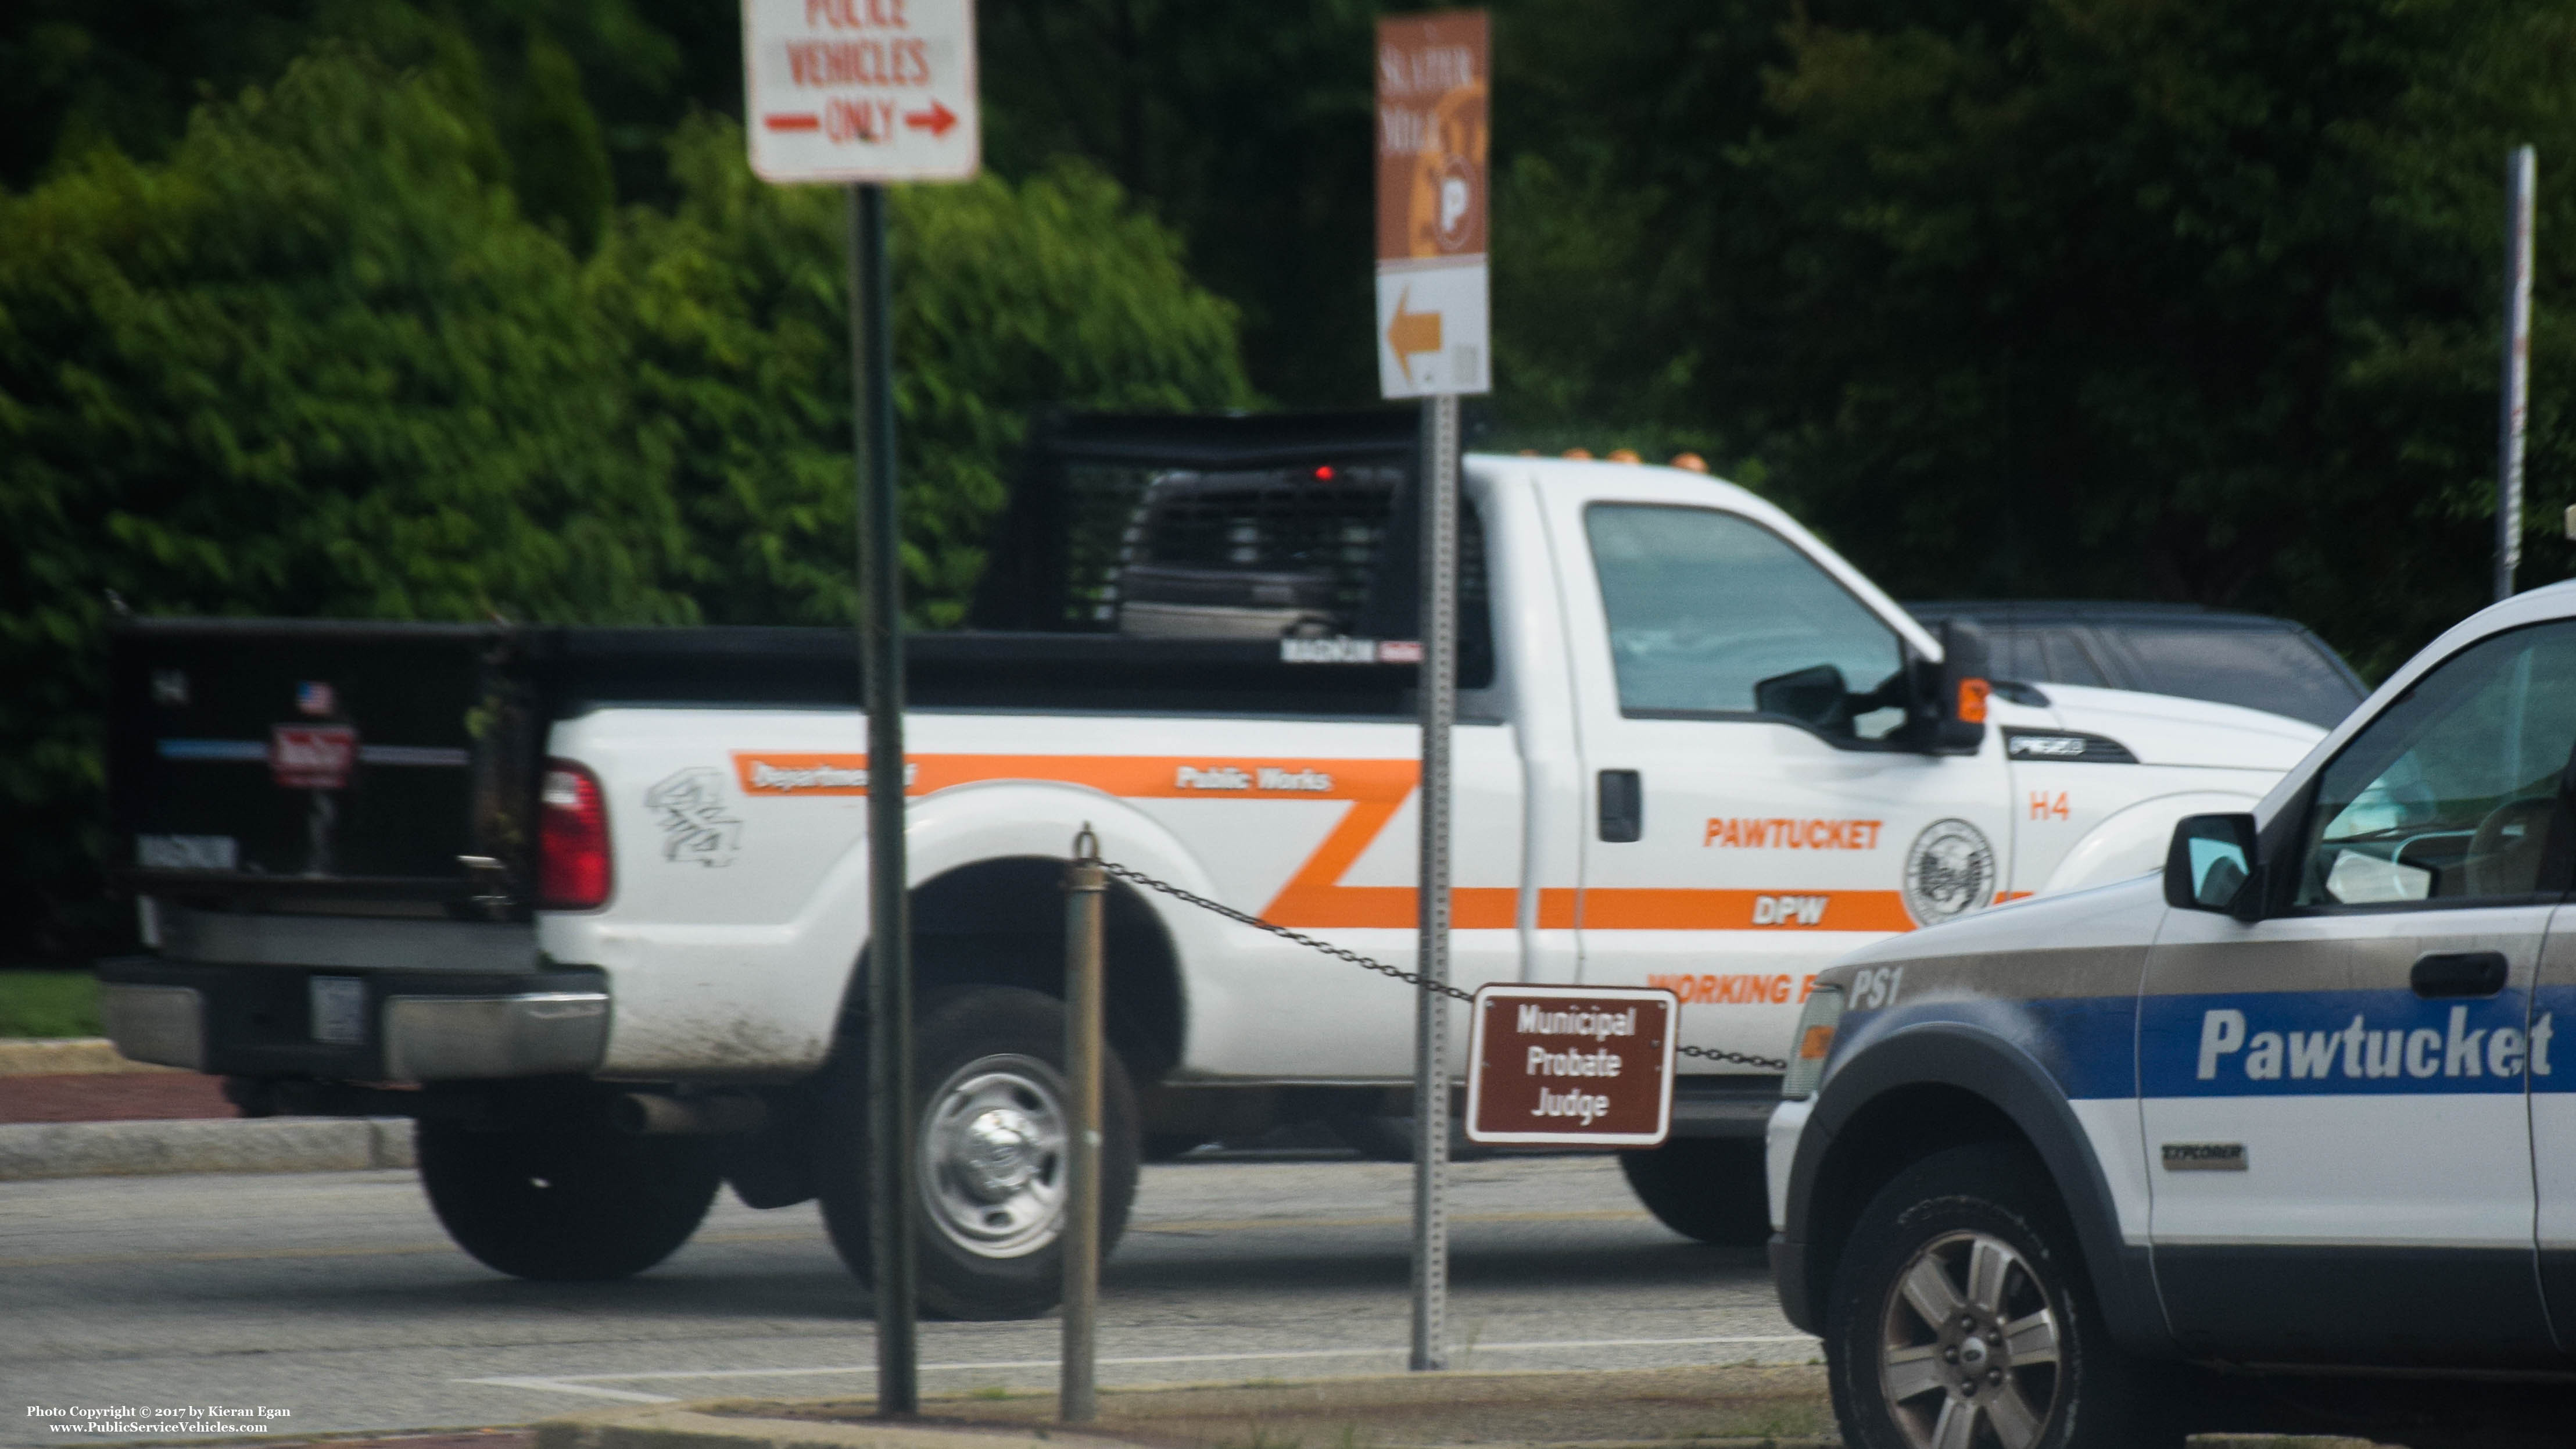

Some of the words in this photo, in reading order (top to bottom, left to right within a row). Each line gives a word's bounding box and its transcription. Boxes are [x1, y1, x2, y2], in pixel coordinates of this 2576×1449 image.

[786, 38, 929, 88] VEHICLES
[825, 97, 895, 144] ONLY
[1440, 178, 1469, 234] P
[1176, 765, 1251, 789] Public
[1256, 767, 1332, 791] Works
[2029, 792, 2071, 820] H4
[1703, 817, 1884, 850] PAWTUCKET
[1752, 893, 1829, 926] DPW
[1848, 967, 1905, 1011] PS1
[1516, 1004, 1638, 1042] Municipal
[1525, 1046, 1623, 1078] Probate
[2196, 1005, 2554, 1081] Pawtucket
[1531, 1087, 1610, 1126] Judge
